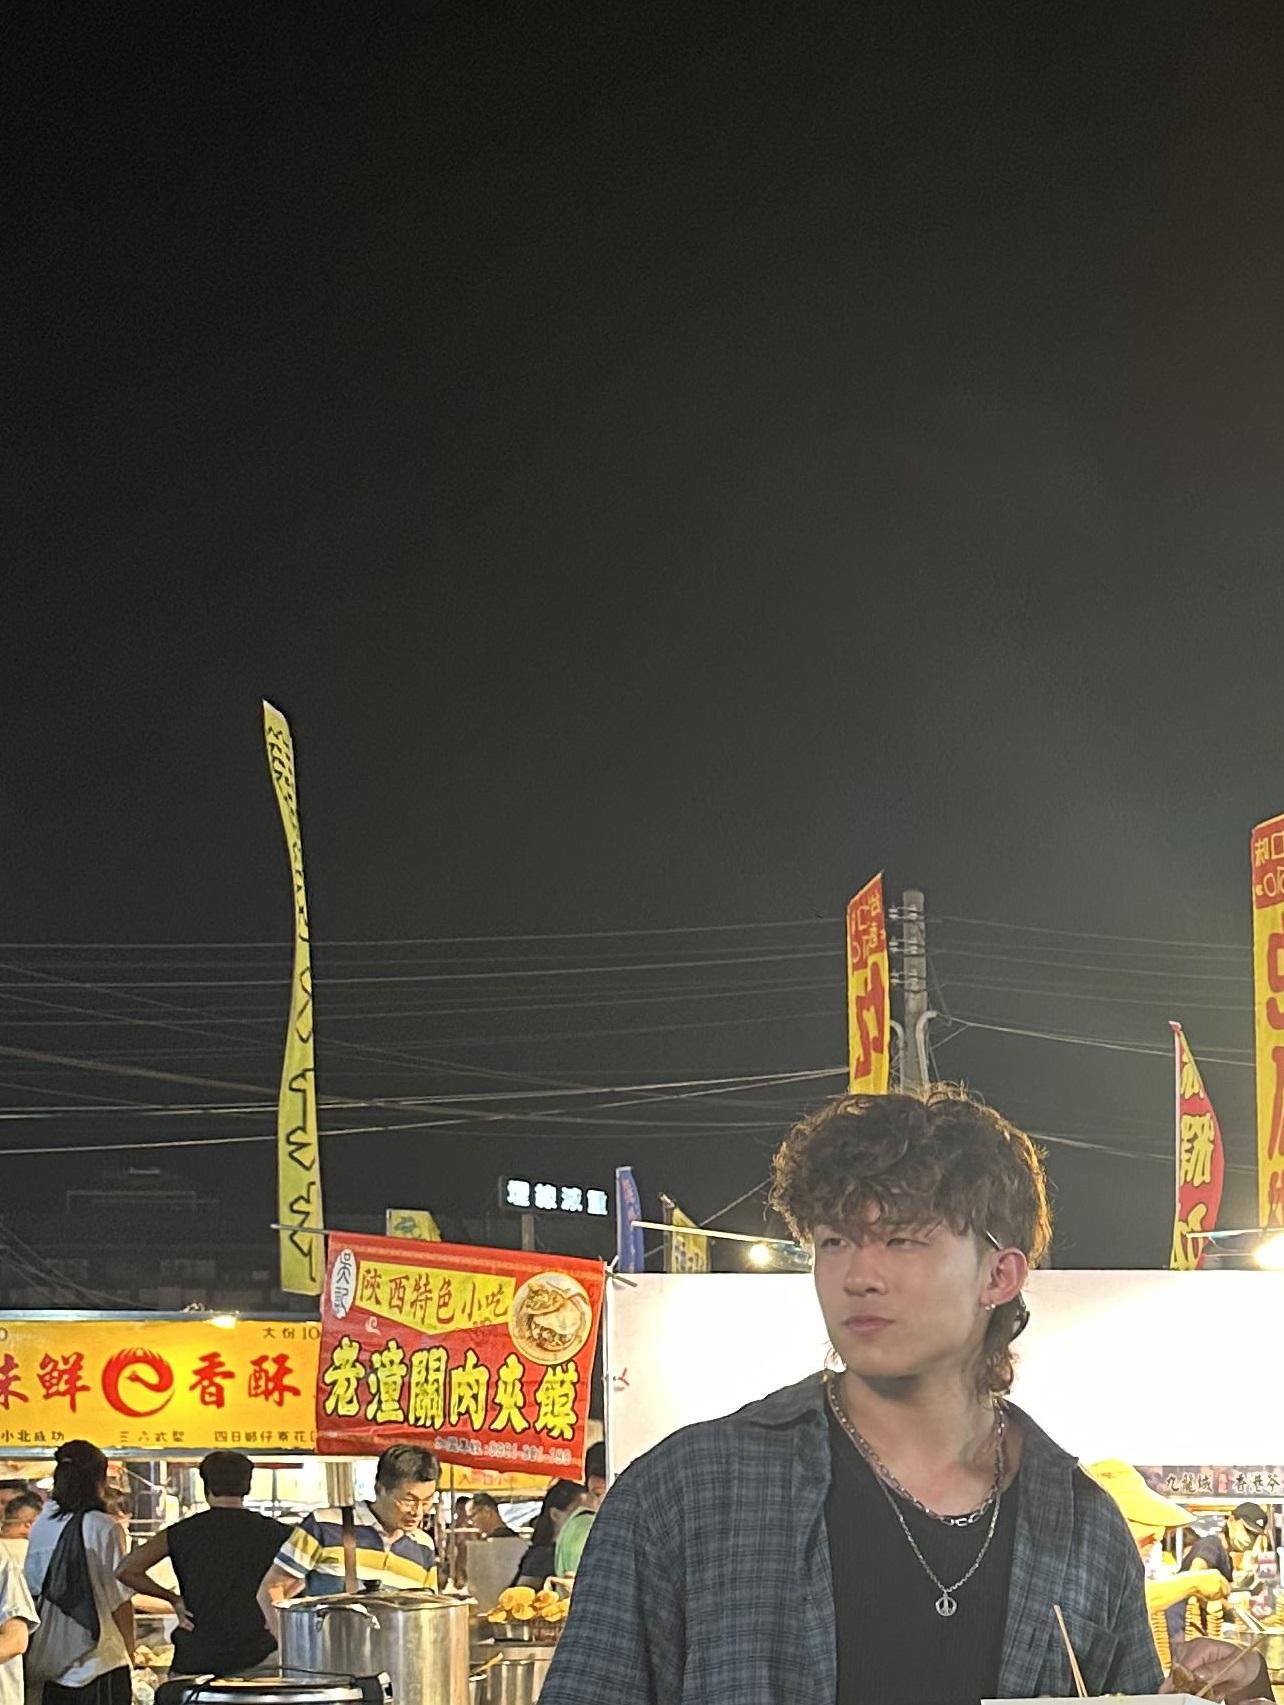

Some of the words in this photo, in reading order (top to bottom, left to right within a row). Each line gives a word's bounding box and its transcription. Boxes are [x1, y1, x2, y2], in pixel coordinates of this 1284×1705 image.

[361, 1267, 508, 1325] 陝西特色小吃
[189, 1351, 302, 1409] 香酥
[323, 1336, 580, 1440] 老潼關肉夾饃
